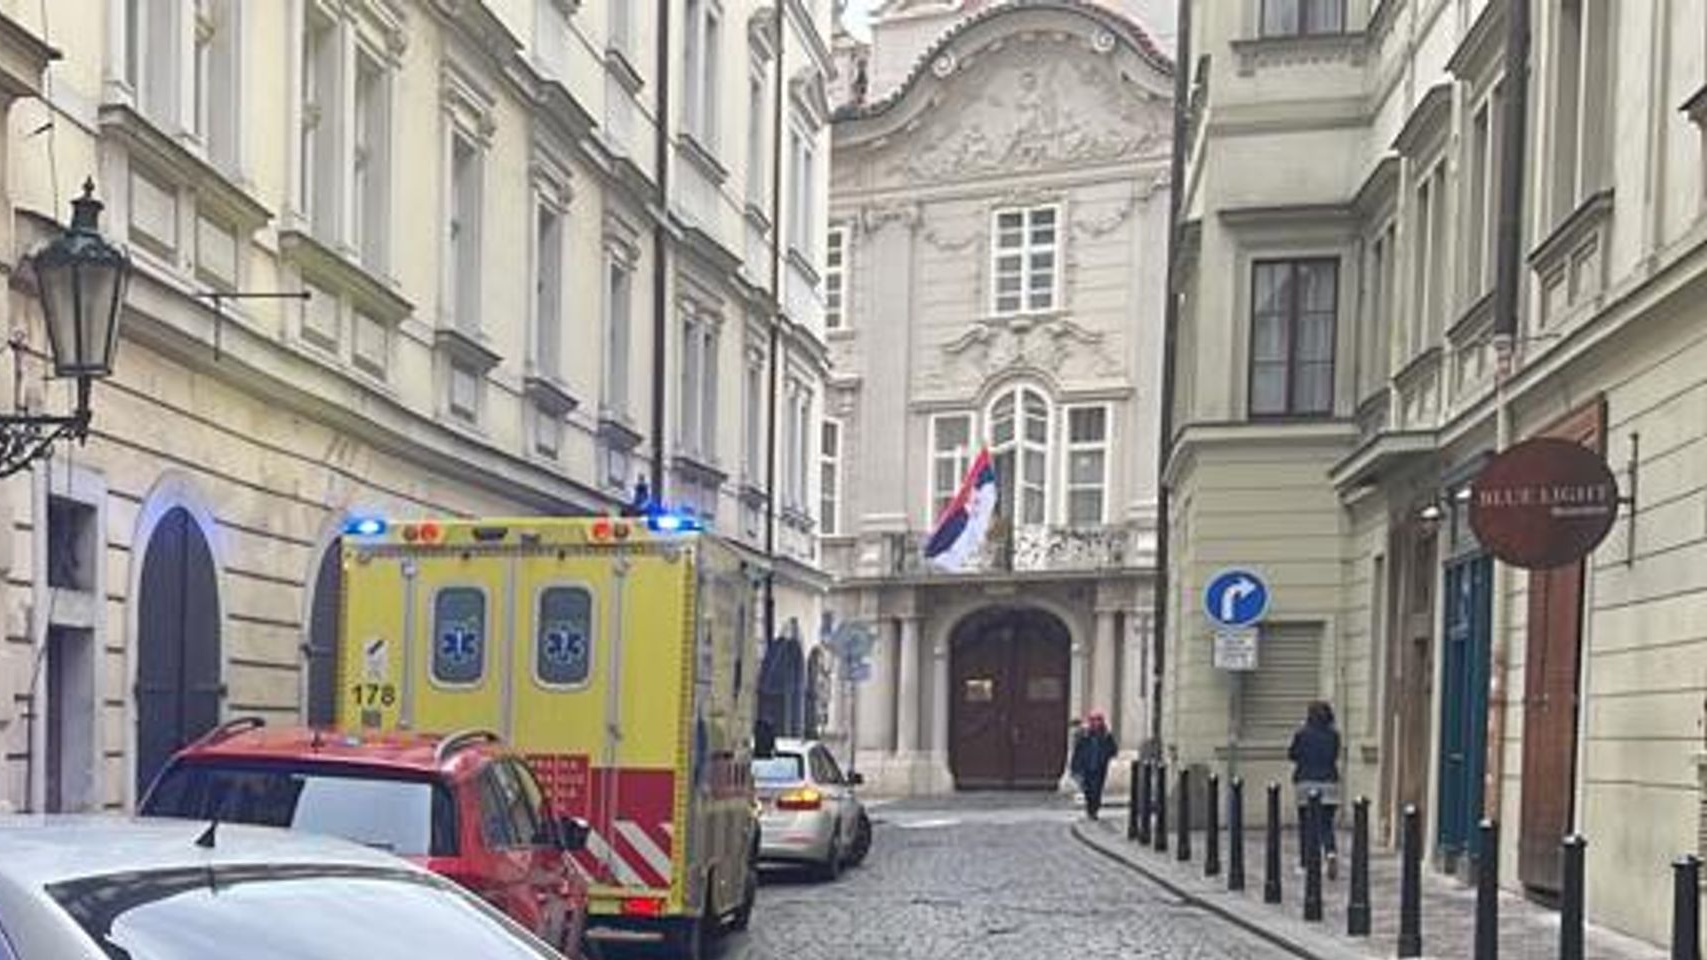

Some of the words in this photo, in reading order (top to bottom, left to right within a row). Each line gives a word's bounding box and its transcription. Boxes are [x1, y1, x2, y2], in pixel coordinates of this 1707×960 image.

[1480, 486, 1530, 507] BLUE
[1540, 483, 1607, 504] LIGHT
[351, 683, 396, 707] 178
